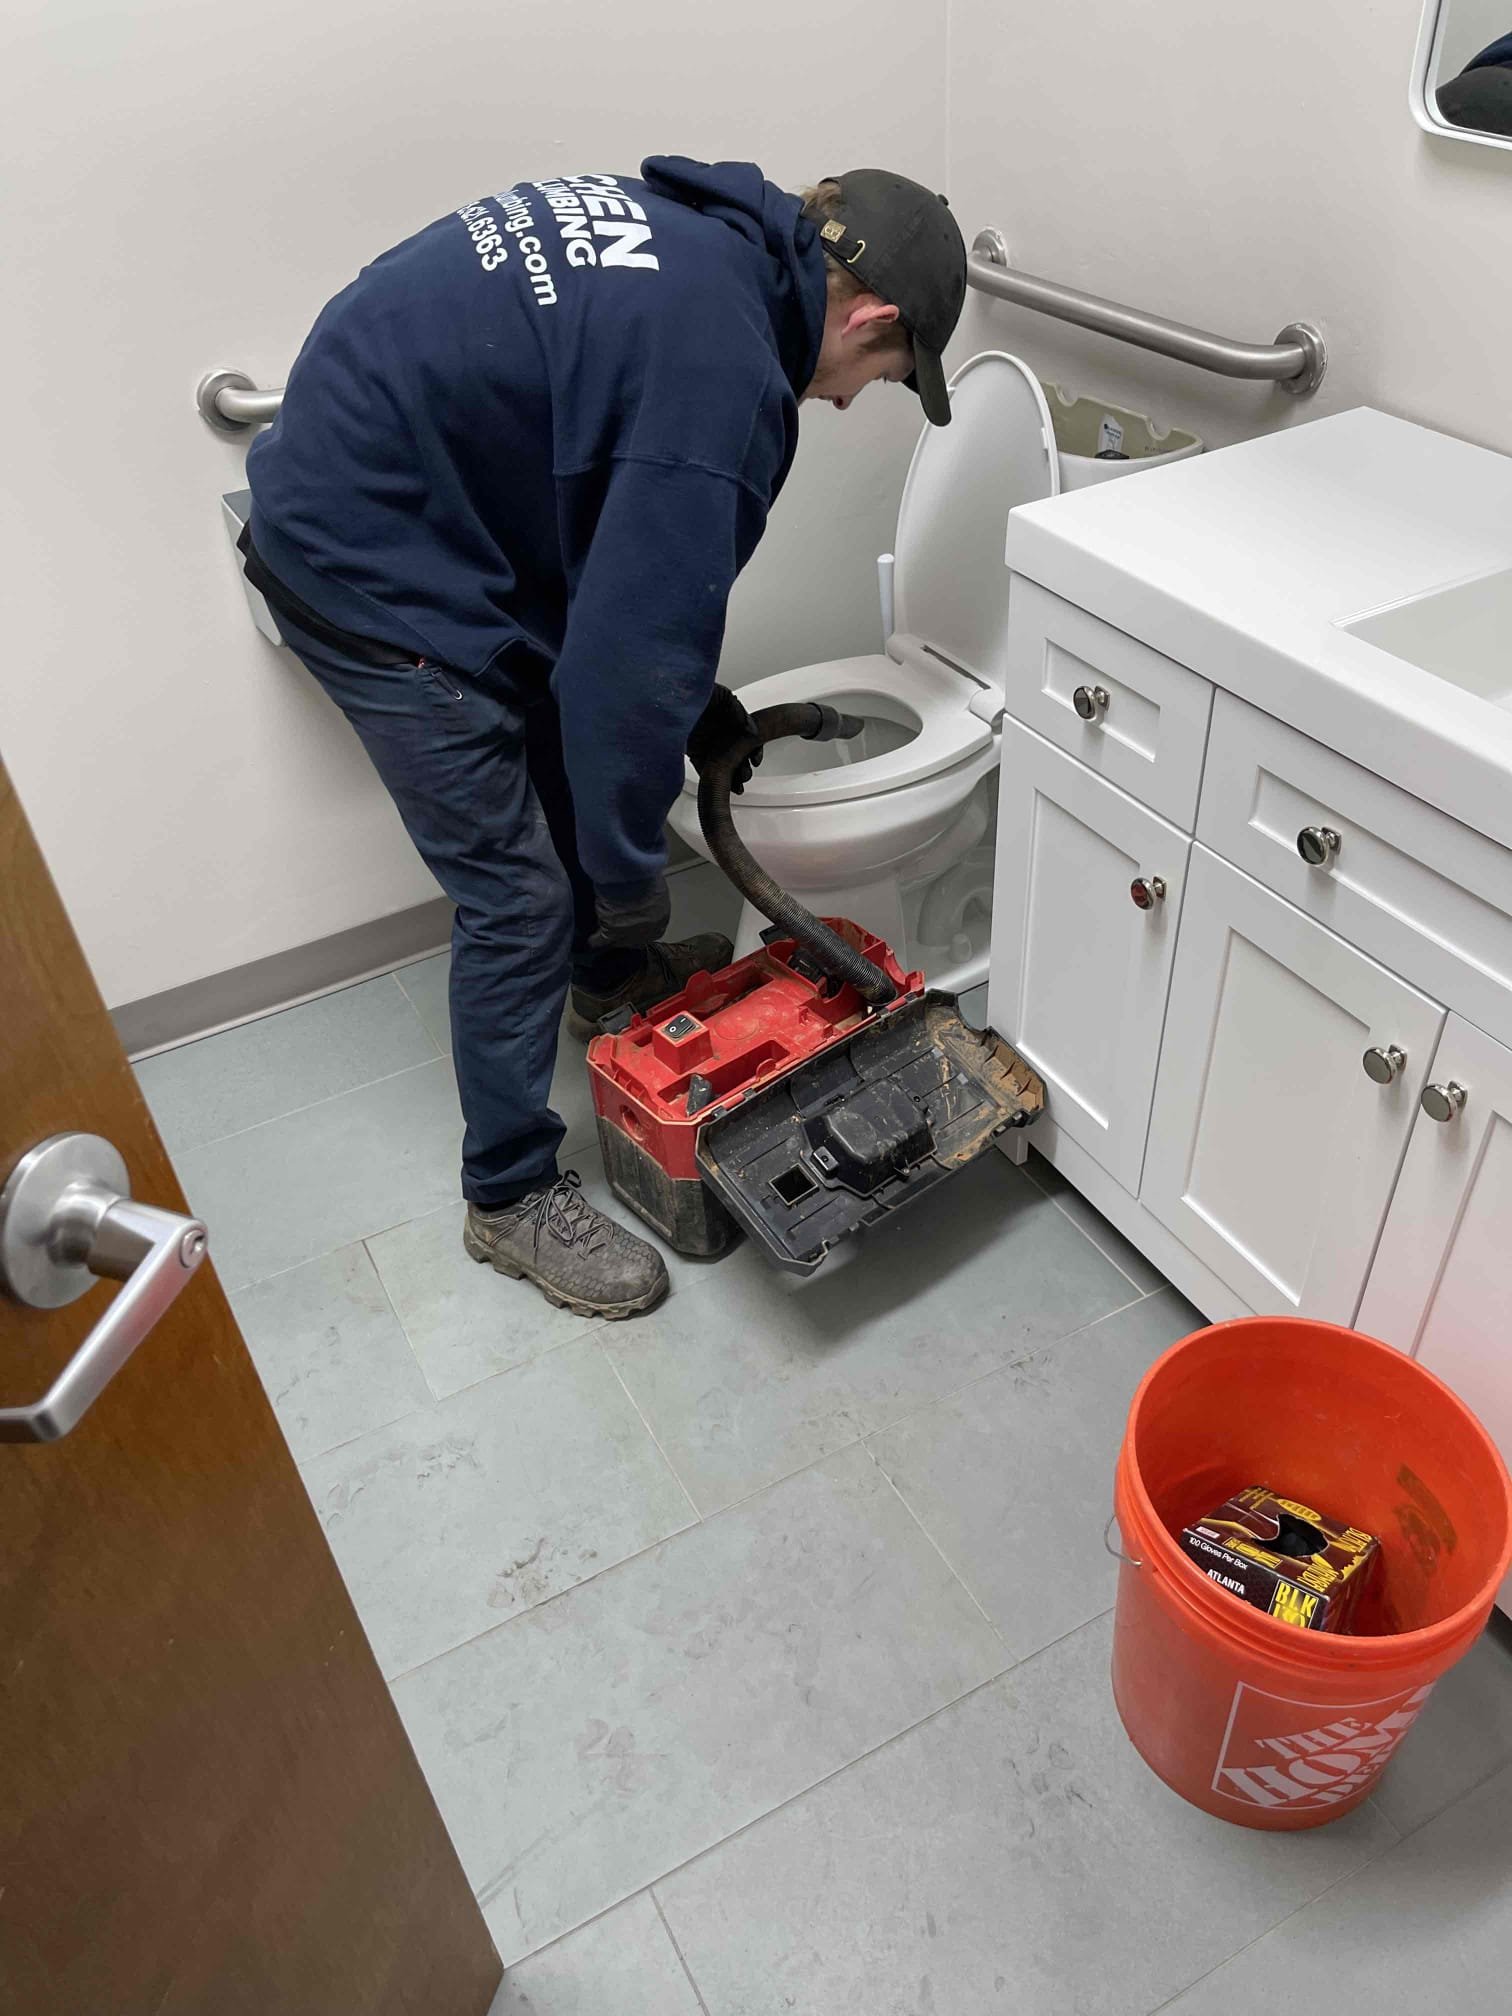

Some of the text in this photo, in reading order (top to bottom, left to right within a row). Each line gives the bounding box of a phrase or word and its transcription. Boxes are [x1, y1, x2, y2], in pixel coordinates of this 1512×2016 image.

[1189, 1536, 1249, 1570] 100 Gloves Per Box
[1206, 1568, 1246, 1595] ATLANTA
[1275, 1582, 1318, 1618] BLK
[1254, 1717, 1373, 1760] THE
